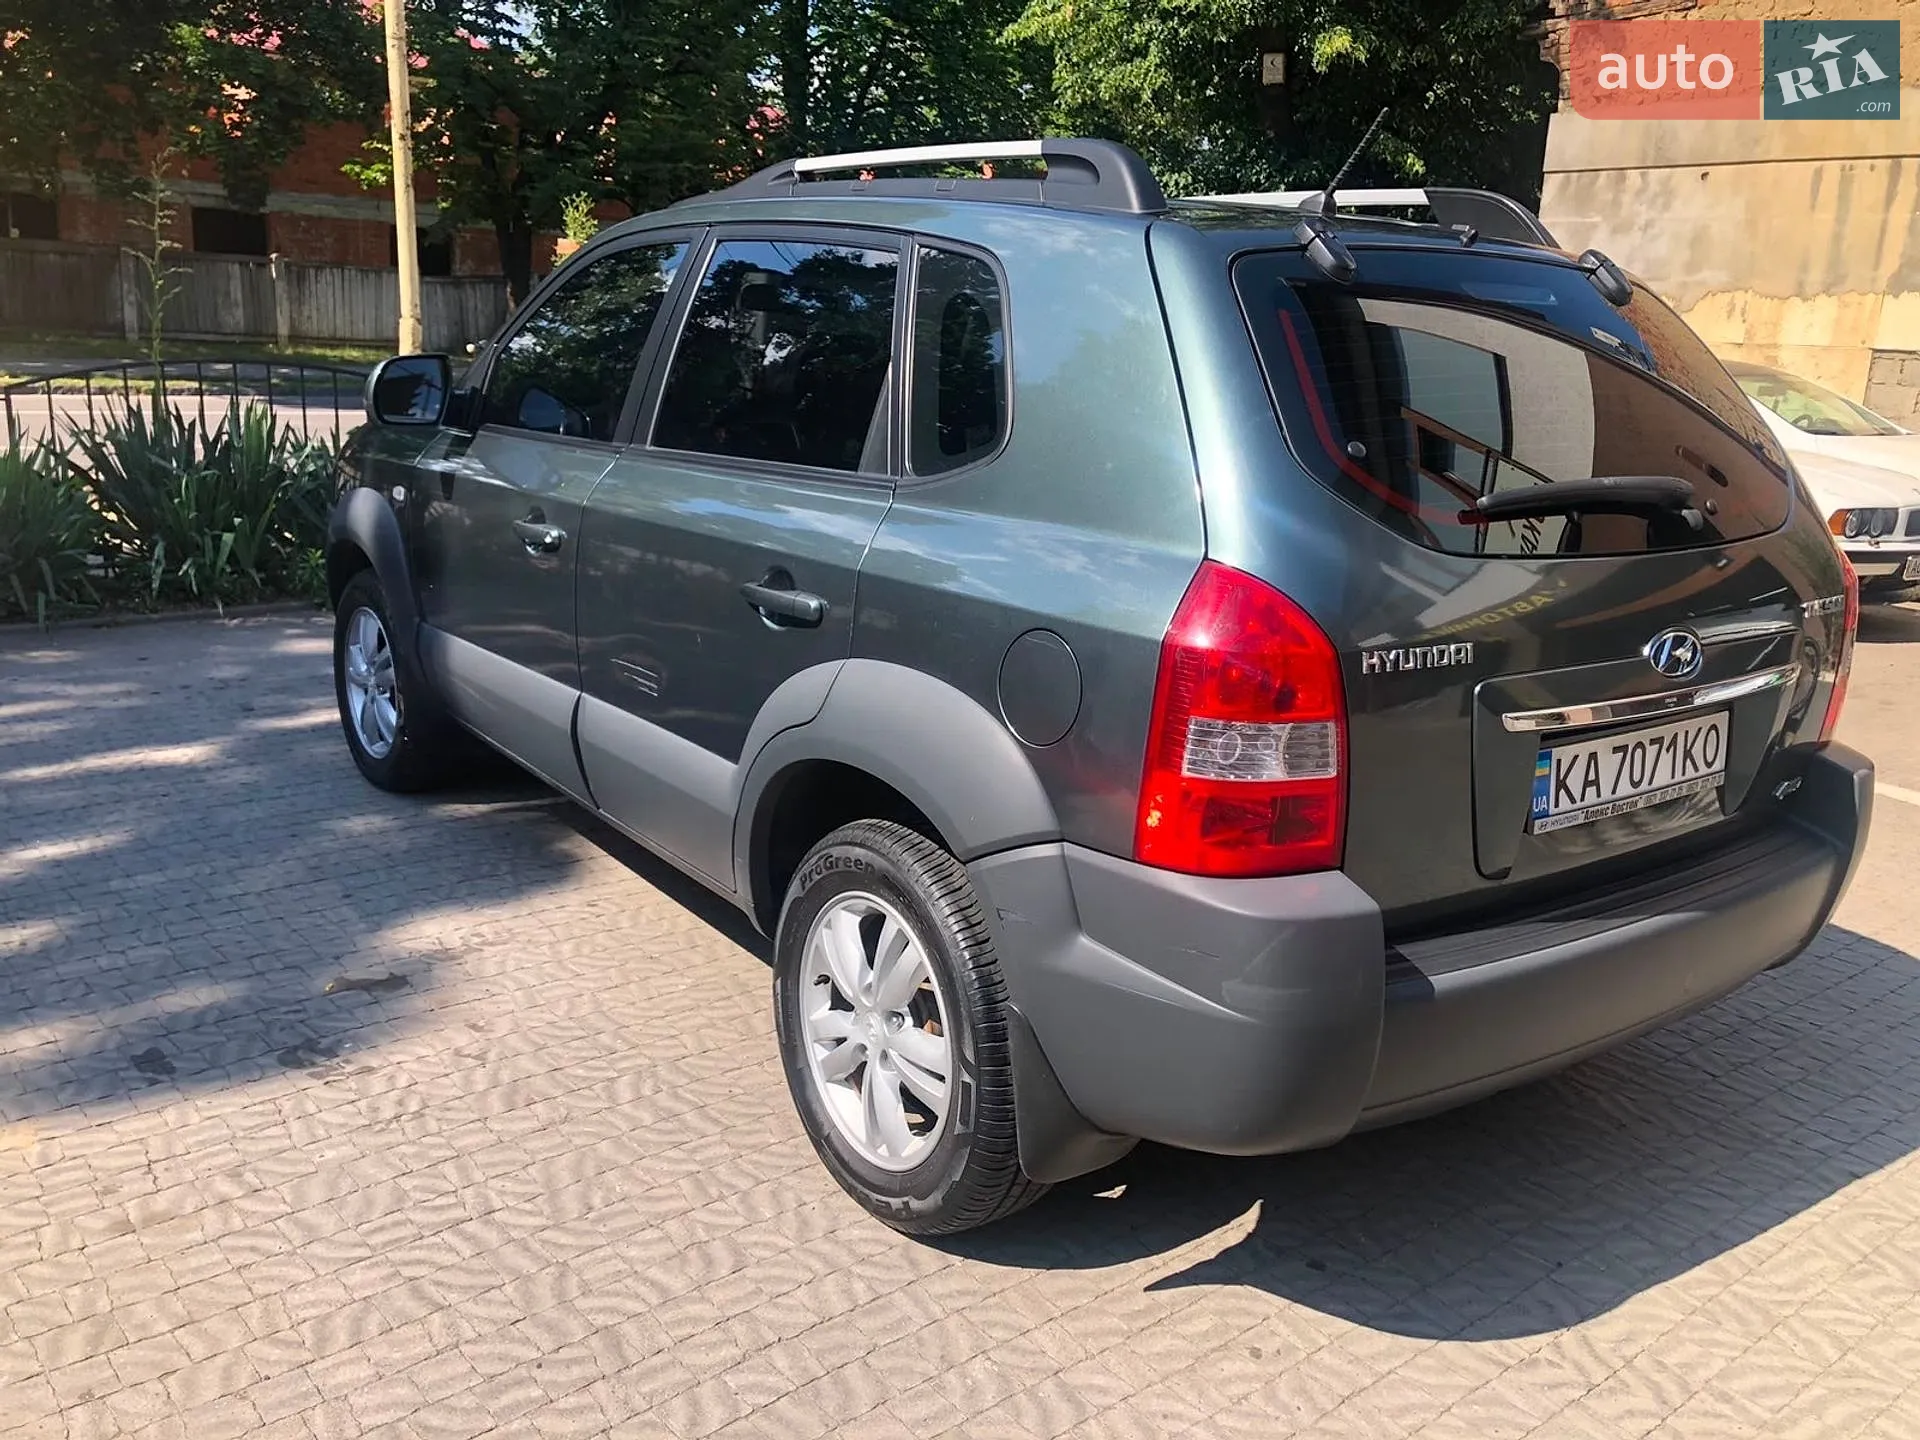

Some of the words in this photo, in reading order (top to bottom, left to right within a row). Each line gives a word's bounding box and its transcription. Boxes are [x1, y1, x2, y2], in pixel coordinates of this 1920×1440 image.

[1362, 642, 1474, 675] HYUNDAI
[1533, 796, 1548, 812] UA
[799, 853, 876, 892] ProGreen
